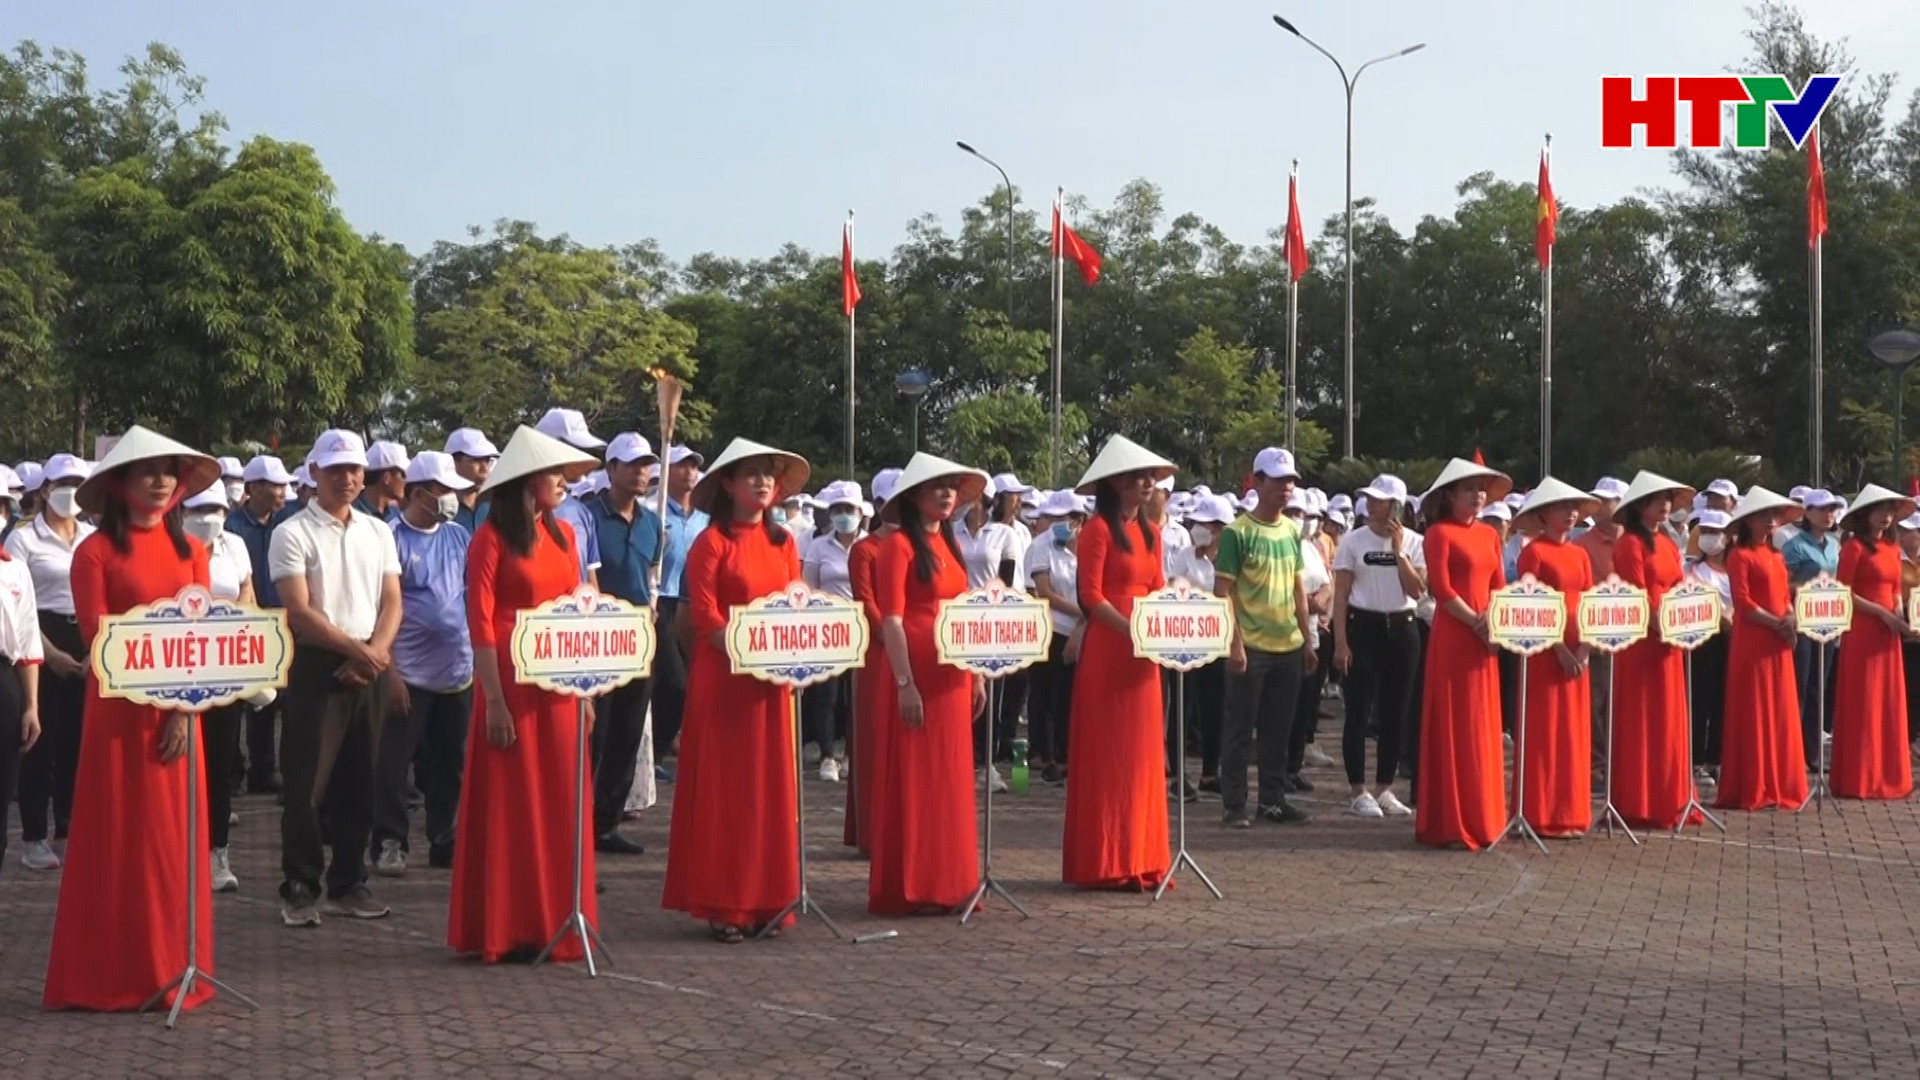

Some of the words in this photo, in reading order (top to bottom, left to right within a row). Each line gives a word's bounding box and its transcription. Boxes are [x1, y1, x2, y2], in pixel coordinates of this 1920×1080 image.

[1499, 604, 1509, 627] XÃ
[1512, 608, 1535, 631] THẠCH
[1537, 608, 1556, 631] NGỌC
[1815, 601, 1829, 617] NAM
[749, 621, 767, 652] XÃ
[772, 625, 817, 655] THẠCH
[822, 622, 850, 649] SƠN
[951, 621, 965, 651] THỊ
[968, 612, 992, 644] TRẤN
[995, 621, 1023, 649] THẠCH
[1026, 614, 1037, 642] HÀ
[1147, 611, 1161, 637] XÃ
[1165, 615, 1194, 643] NGỌC
[1198, 614, 1220, 637] SƠN
[124, 633, 154, 669] XÃ
[162, 631, 209, 674] VIỆT
[216, 624, 265, 665] TIẾN
[534, 627, 552, 659] XÃ
[557, 631, 599, 664] THẠCH
[604, 629, 636, 658] LONG
